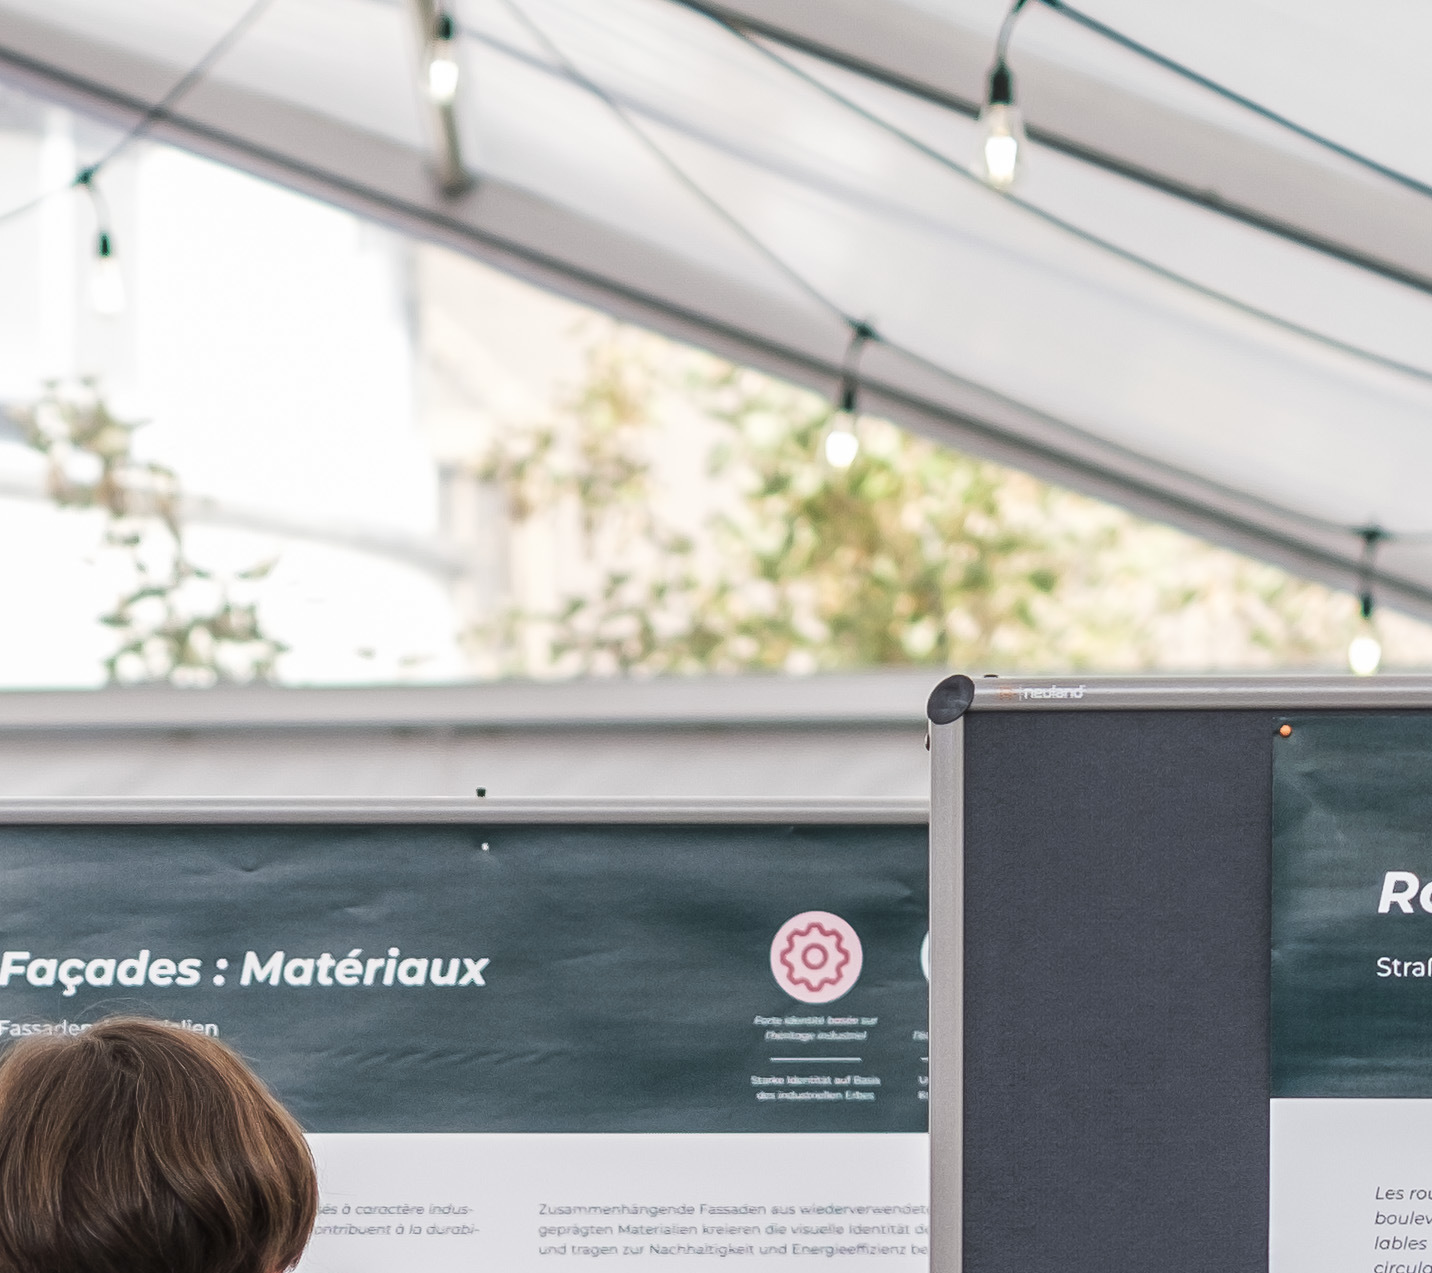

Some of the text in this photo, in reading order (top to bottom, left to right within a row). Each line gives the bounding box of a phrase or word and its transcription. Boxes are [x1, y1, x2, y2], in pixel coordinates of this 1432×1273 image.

[213, 957, 228, 986] :
[240, 947, 490, 986] Matériaux
[1374, 1185, 1405, 1201] Les
[1373, 1235, 1428, 1251] lables
